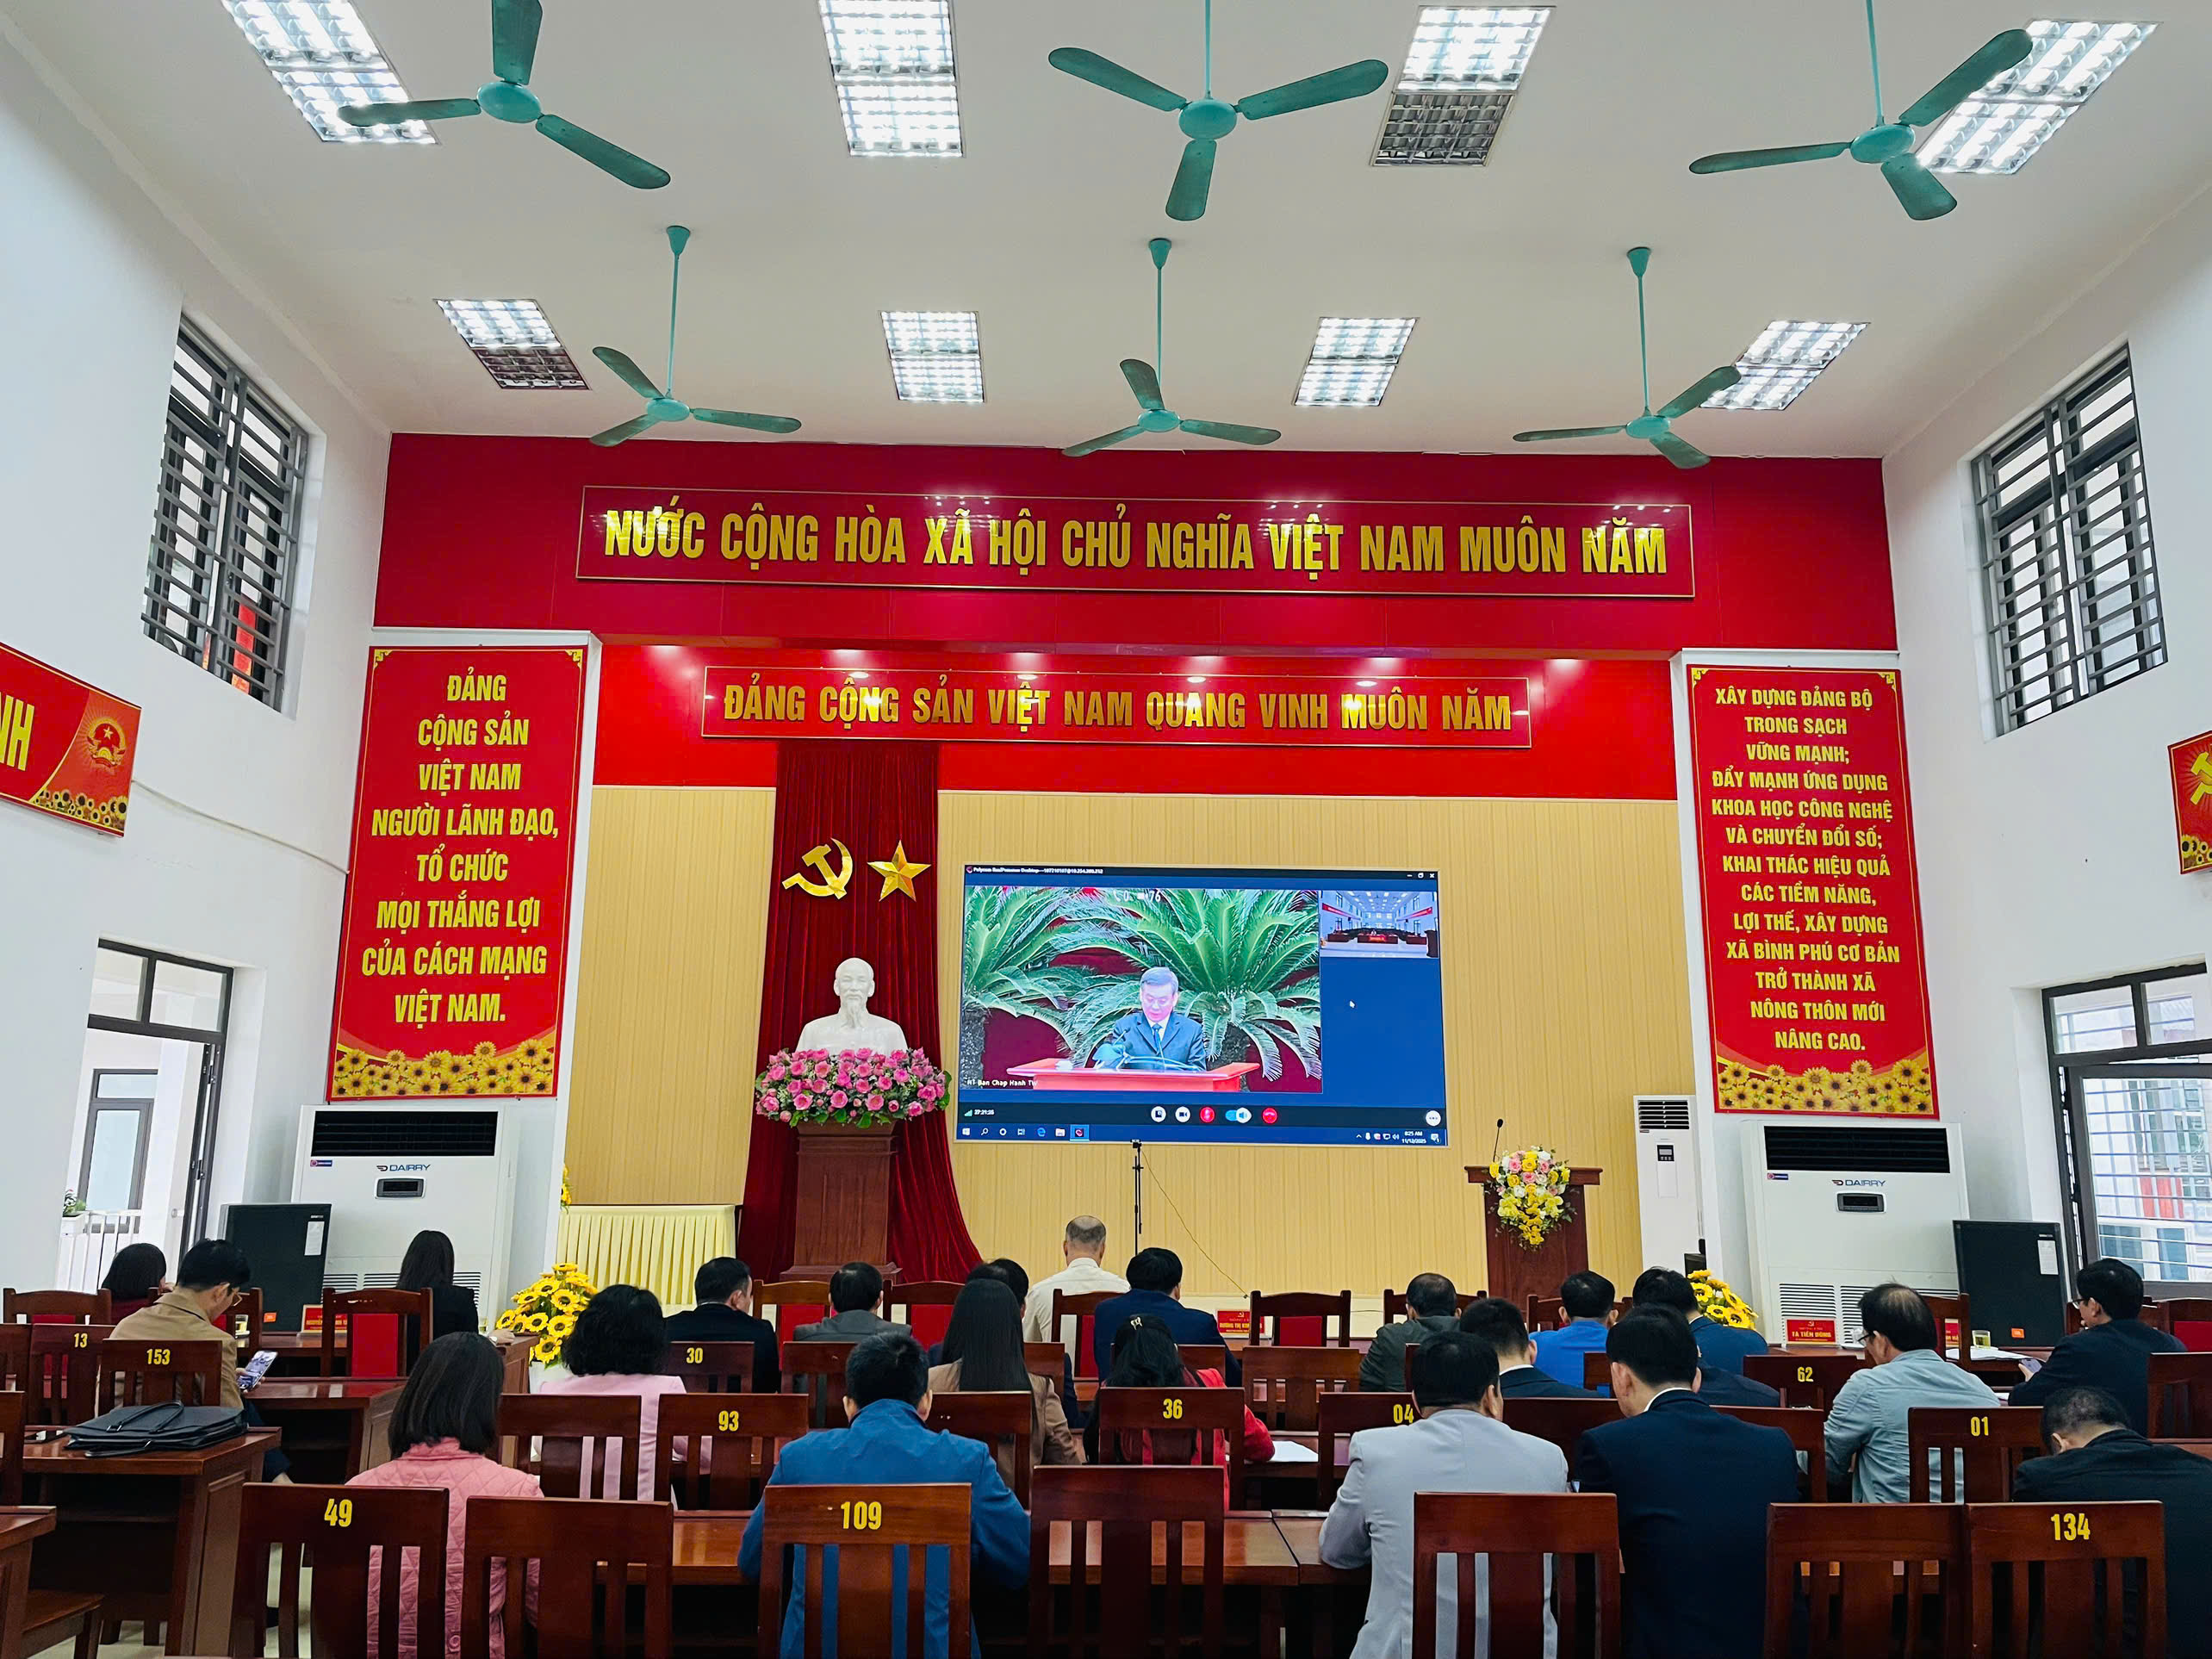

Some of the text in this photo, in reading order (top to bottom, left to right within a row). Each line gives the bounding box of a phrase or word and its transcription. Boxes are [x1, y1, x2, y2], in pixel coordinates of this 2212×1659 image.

[601, 495, 1666, 580] NƯỚC CỘNG HÒA XÃ HỘI CHỦ NGHĨA VIỆT NAM MUÔN NĂM
[448, 667, 506, 700] ĐẢNG
[724, 673, 1511, 731] ĐẢNG CỘNG SẢN VIỆT NAM QUANG VINH MUÔN NĂM
[1716, 686, 1873, 710] XÂY DỰNG ĐẢNG BỘ
[419, 711, 529, 751] CỘNG SẢN
[1745, 717, 1847, 737] TRONG SẠCH
[1747, 742, 1849, 765] VỮNG MẠNH;
[419, 758, 521, 796] VIỆT NAM
[1712, 765, 1887, 793] ĐẨY MẠNH ỨNG DỤNG
[372, 803, 558, 841] NGƯỜI LÃNH ĐẠO,
[1712, 798, 1892, 822] KHOA HỌC CÔNG NGHỆ
[1726, 823, 1882, 848] VÀ CHUYỂN ĐỔI SỐ;
[417, 843, 508, 881] TỔ CHỨC
[1723, 854, 1890, 878] KHAI THÁC HIỆU QUẢ
[1742, 881, 1876, 905] CÁC TIỀM NĂNG,
[376, 890, 540, 935] MỌI THẮNG LỢI
[1734, 910, 1887, 936] LỢI THẾ, XÂY DỰNG
[362, 938, 547, 980] CỦA CÁCH MẠNG
[1726, 939, 1899, 962] XÃ BÌNH PHÚ CƠ BẢN
[1755, 967, 1875, 991] TRỞ THÀNH XÃ
[395, 989, 506, 1028] VIỆT NAM.
[1750, 998, 1885, 1021] NÔNG THÔN MỚI
[1775, 1028, 1865, 1050] NÂNG CAO.
[74, 1333, 87, 1347] 13
[147, 1349, 170, 1364] 153
[687, 1348, 703, 1364] 30
[1798, 1367, 1813, 1382] 62
[719, 1411, 738, 1431] 93
[1163, 1399, 1182, 1419] 36
[1394, 1404, 1414, 1424] 04
[1971, 1417, 1988, 1436] 01
[325, 1499, 352, 1526] 49
[841, 1501, 881, 1530] 109
[2051, 1513, 2090, 1540] 134
